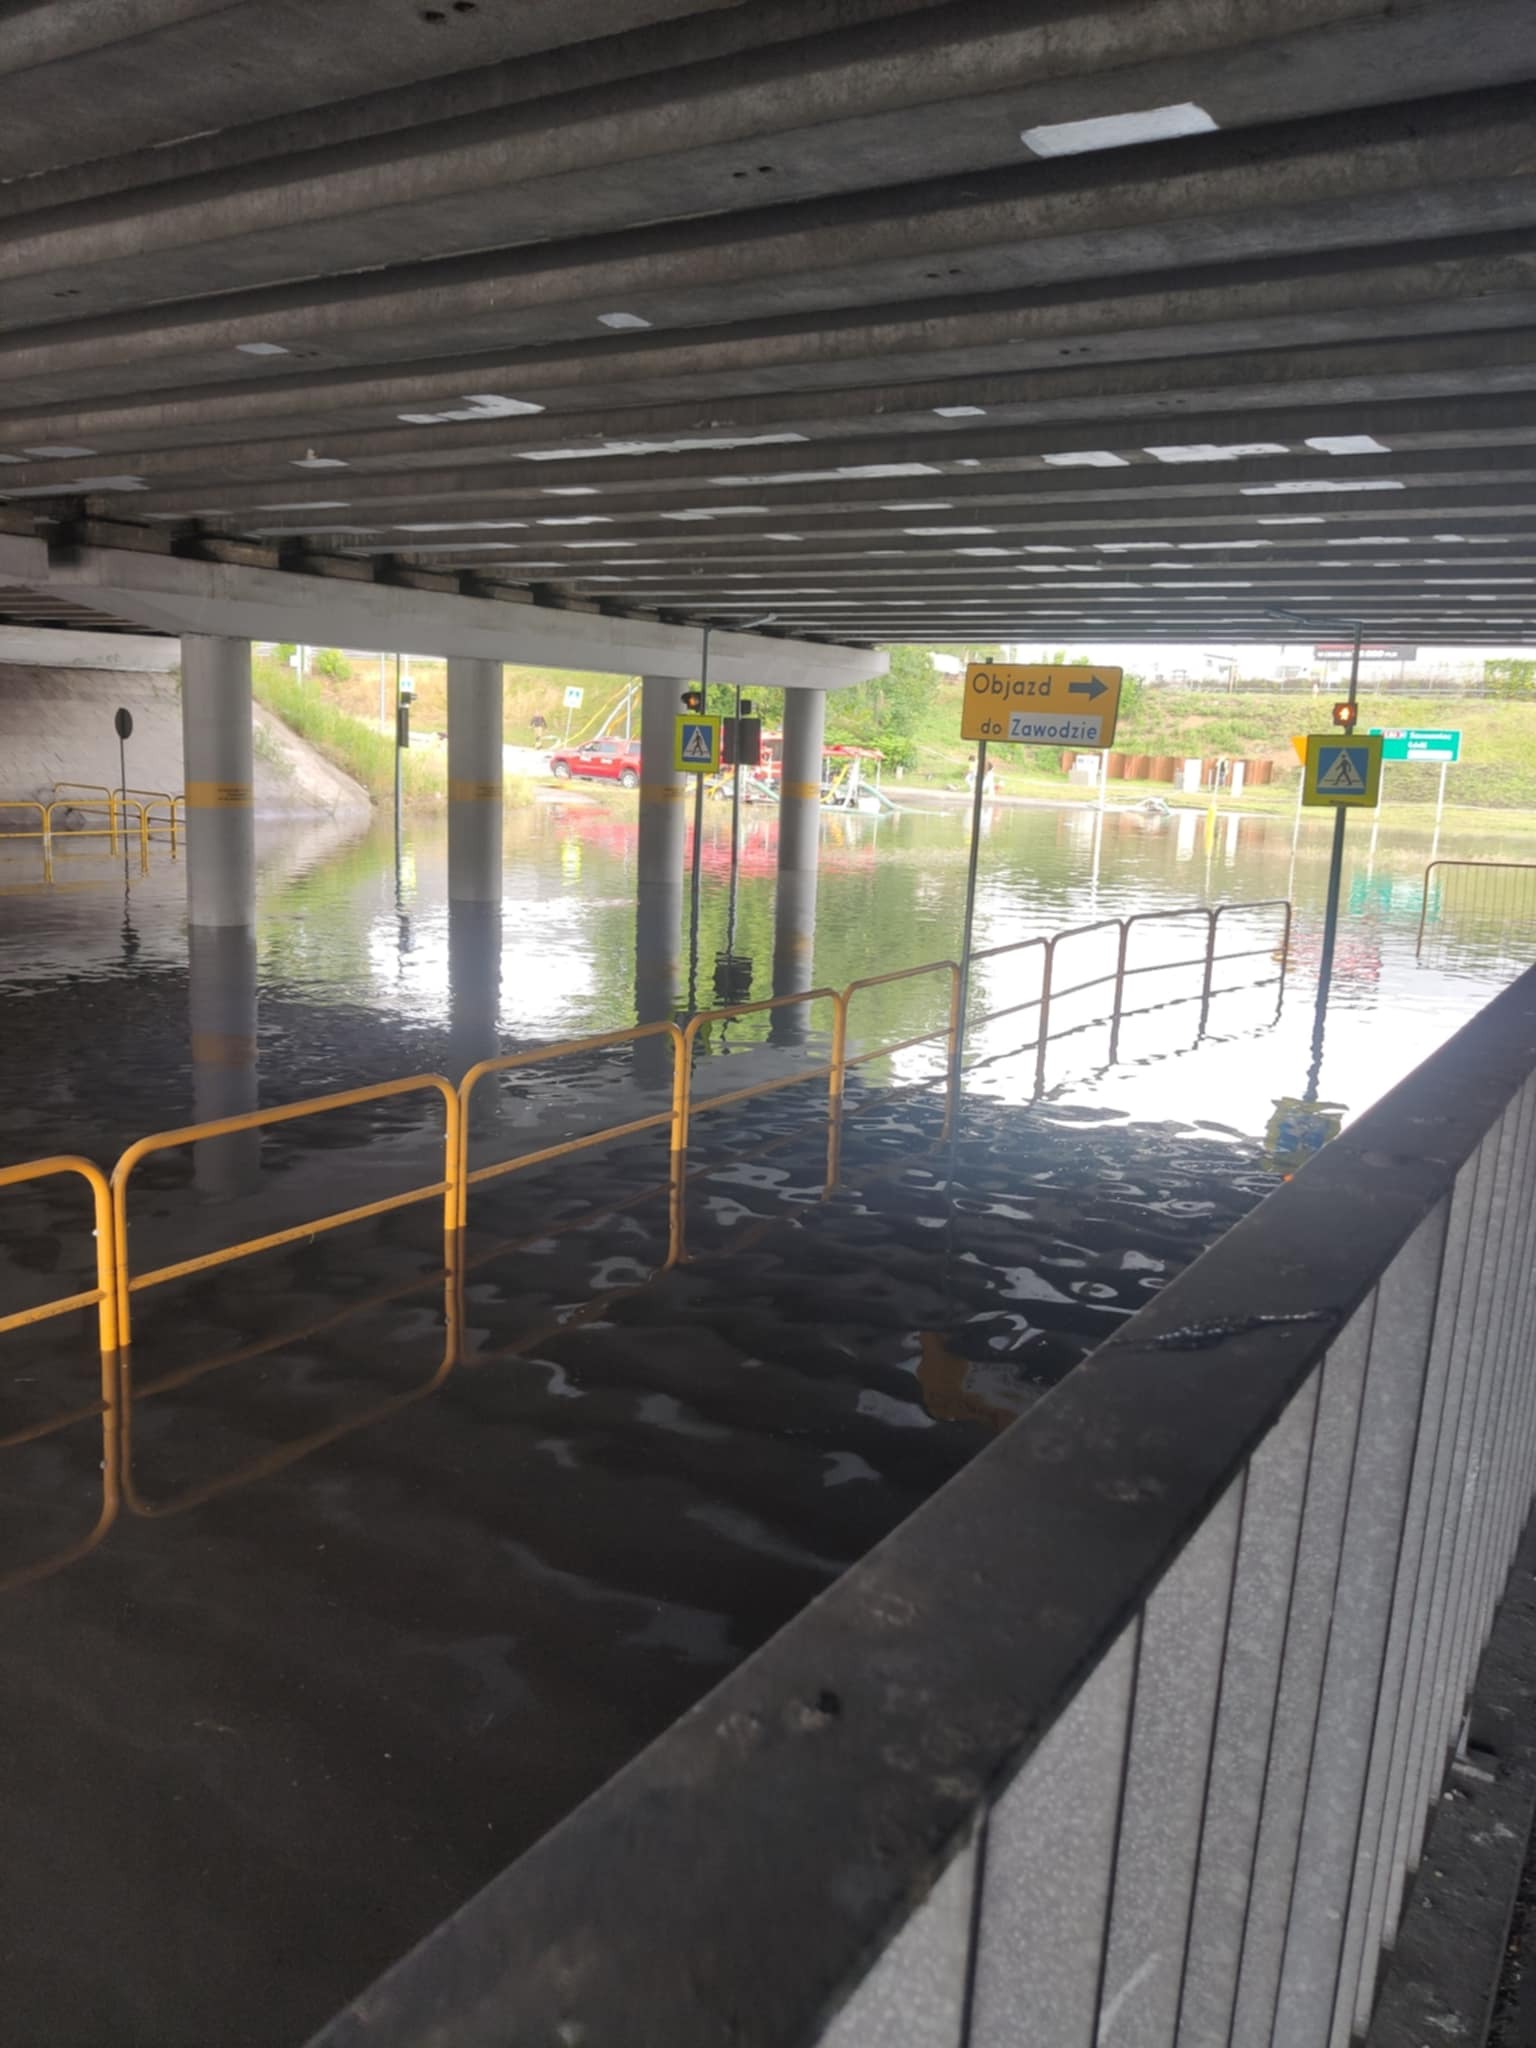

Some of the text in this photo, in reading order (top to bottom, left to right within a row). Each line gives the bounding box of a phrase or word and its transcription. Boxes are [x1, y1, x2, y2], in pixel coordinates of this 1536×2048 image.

[972, 672, 1052, 701] Objazd
[980, 718, 1098, 740] do Zawodzie
